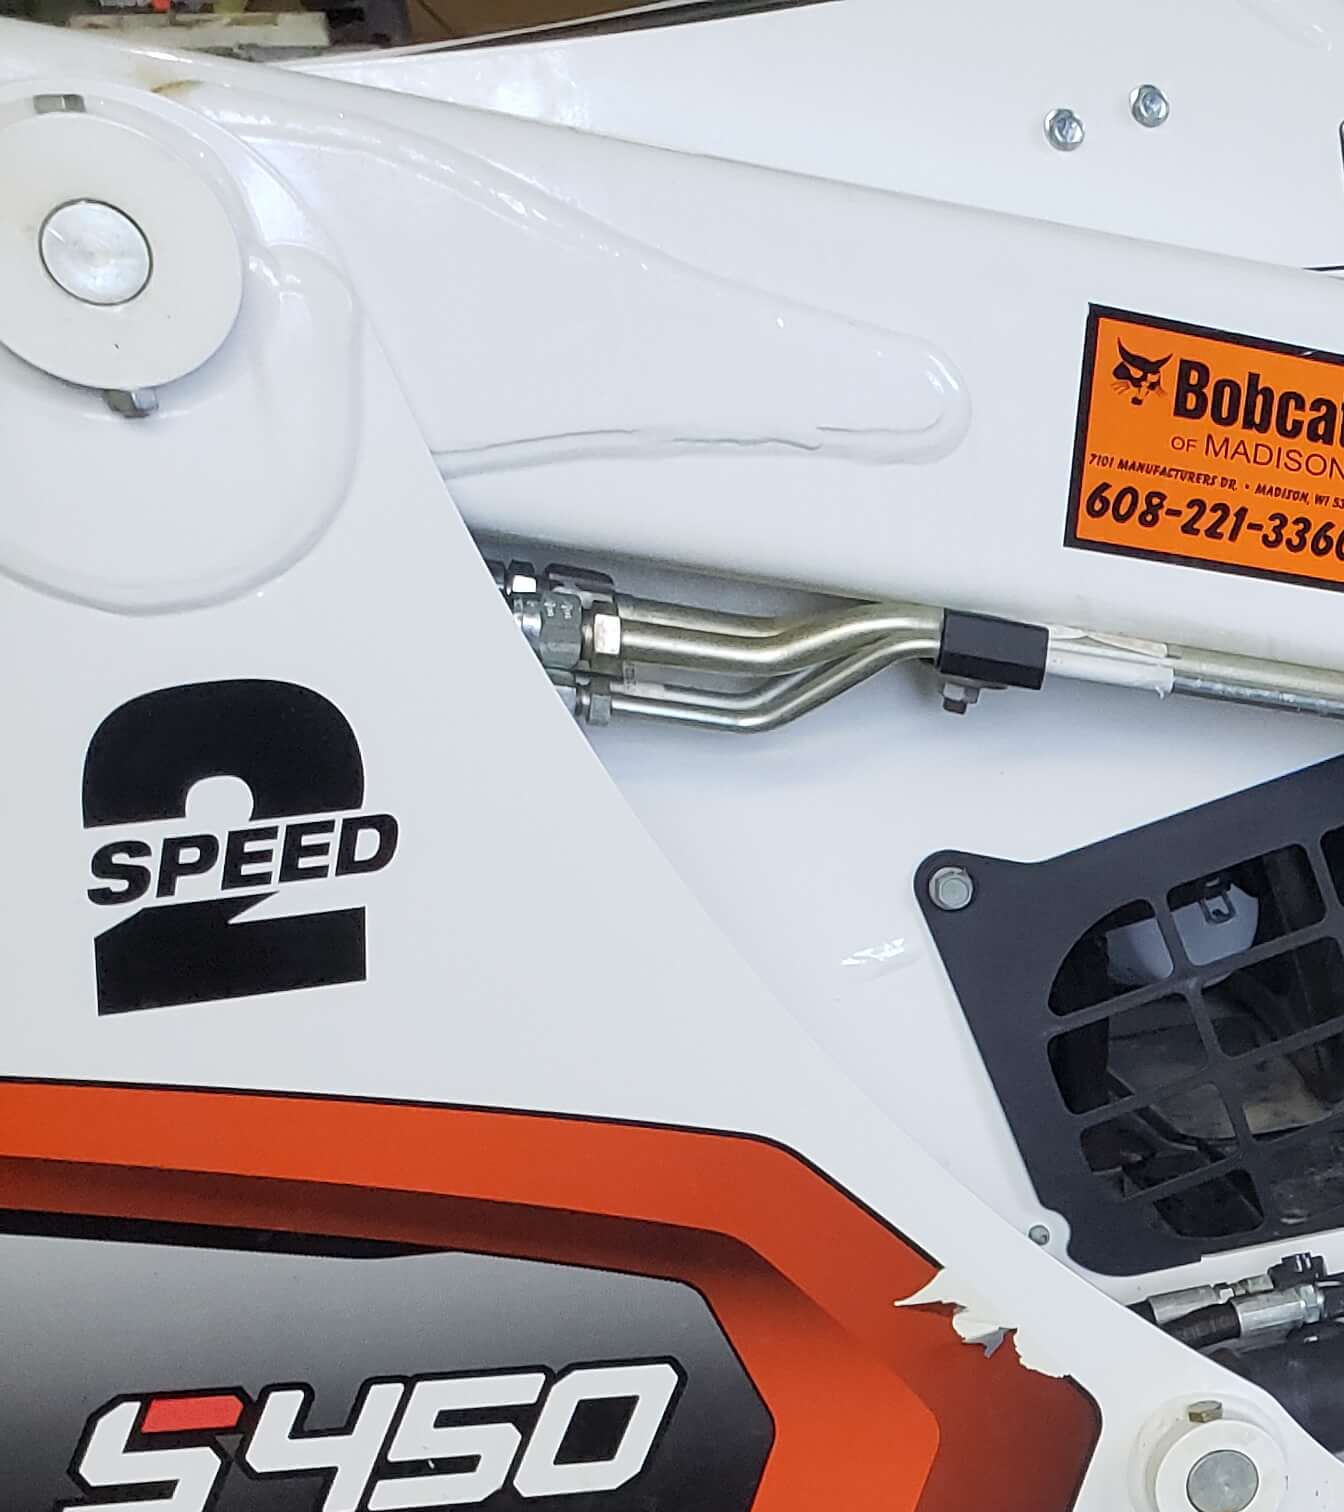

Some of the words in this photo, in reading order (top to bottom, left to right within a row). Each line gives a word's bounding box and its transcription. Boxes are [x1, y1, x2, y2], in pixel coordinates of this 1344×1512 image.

[1089, 453, 1114, 468] 7101
[1117, 459, 1218, 487] MANUFACTURERS
[1220, 476, 1238, 491] DR.
[1255, 483, 1310, 506] MADISON,
[1314, 494, 1330, 506] WI
[1171, 435, 1198, 453] OF
[81, 678, 368, 1017] 2
[87, 813, 400, 907] SPEED
